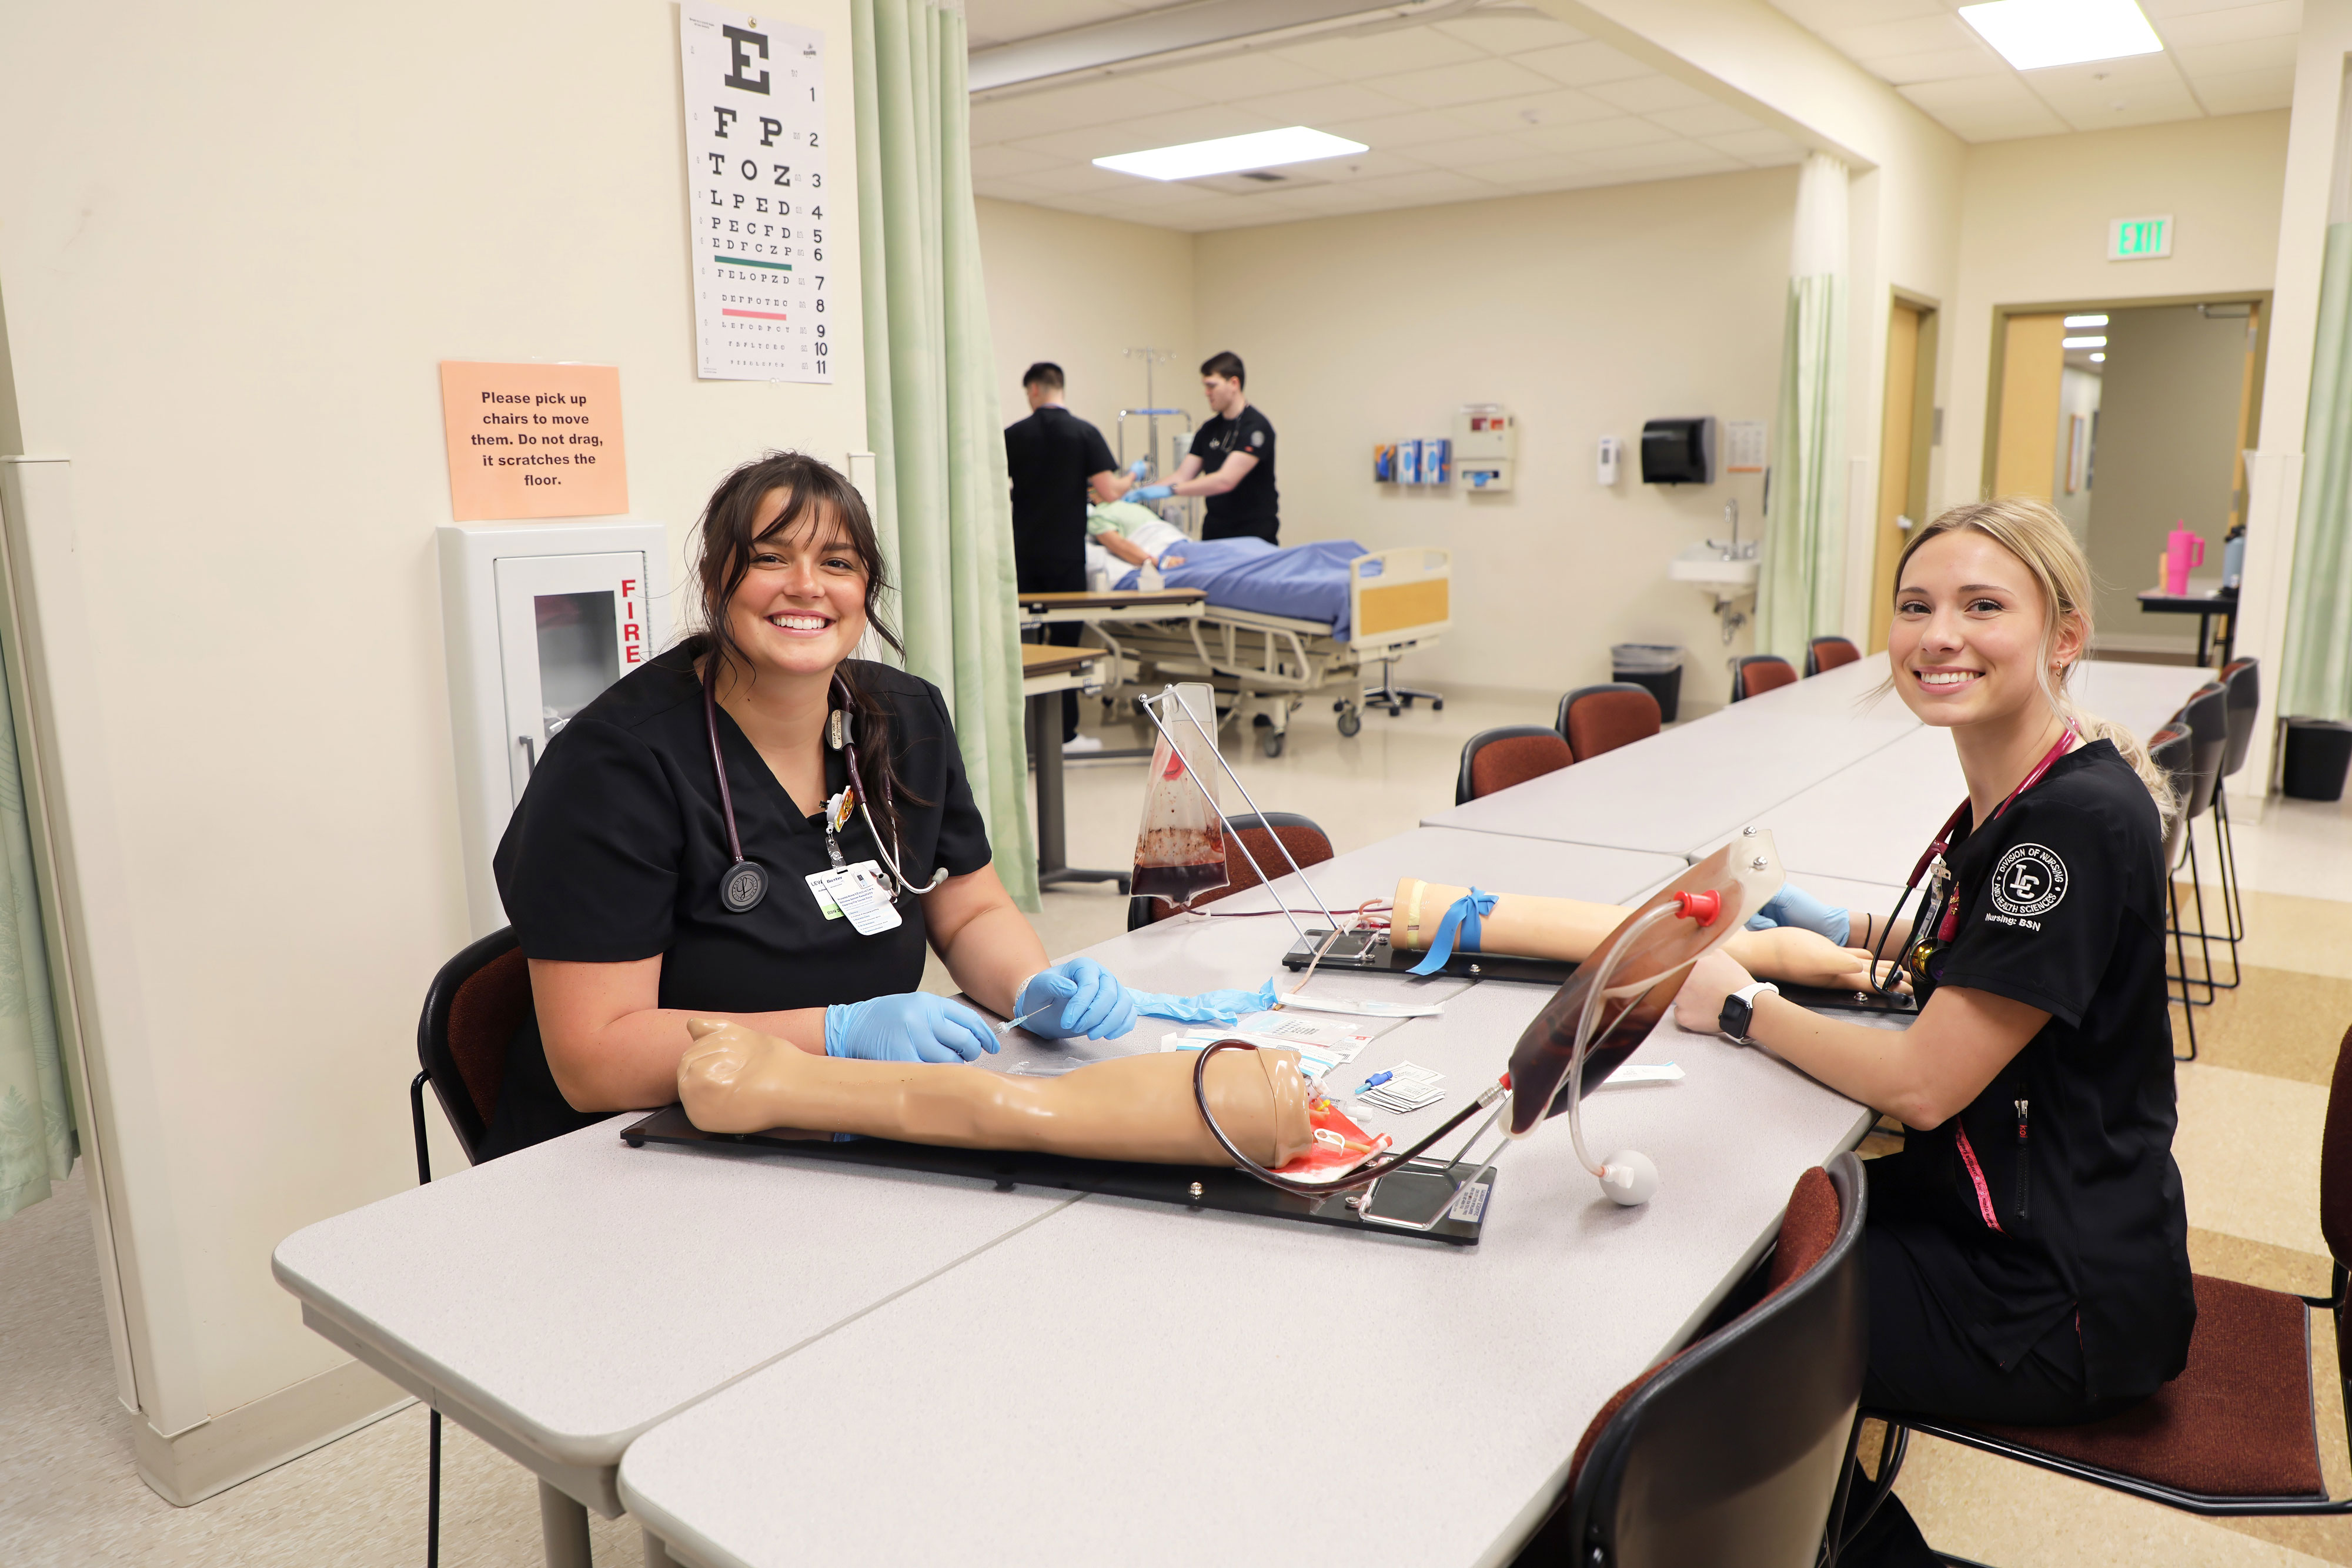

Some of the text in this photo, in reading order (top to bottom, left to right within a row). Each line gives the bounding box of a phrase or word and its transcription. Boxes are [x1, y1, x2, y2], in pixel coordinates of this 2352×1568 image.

[722, 24, 815, 102] E 1
[809, 132, 819, 148] 2
[812, 173, 821, 189] 3
[811, 205, 823, 220] 4
[813, 229, 823, 244] 5
[2118, 220, 2165, 255] EXIT
[814, 248, 823, 262] 6
[814, 275, 825, 291] 7
[816, 299, 825, 313] 8
[816, 324, 826, 338] 9
[814, 342, 828, 356] 10
[816, 360, 826, 375] 11
[482, 392, 587, 407] Please pick up
[483, 413, 589, 424] chairs to move
[470, 433, 603, 447] them. Do not drag,
[482, 453, 596, 466] it scratches the
[524, 474, 562, 486] floor.
[622, 579, 641, 664] FIRE
[2000, 848, 2064, 883] DIVISION OF NURSING
[1996, 896, 2019, 914] HEALTH
[2019, 892, 2057, 914] SCIENCES
[1985, 912, 2042, 932] Nursing: BSN
